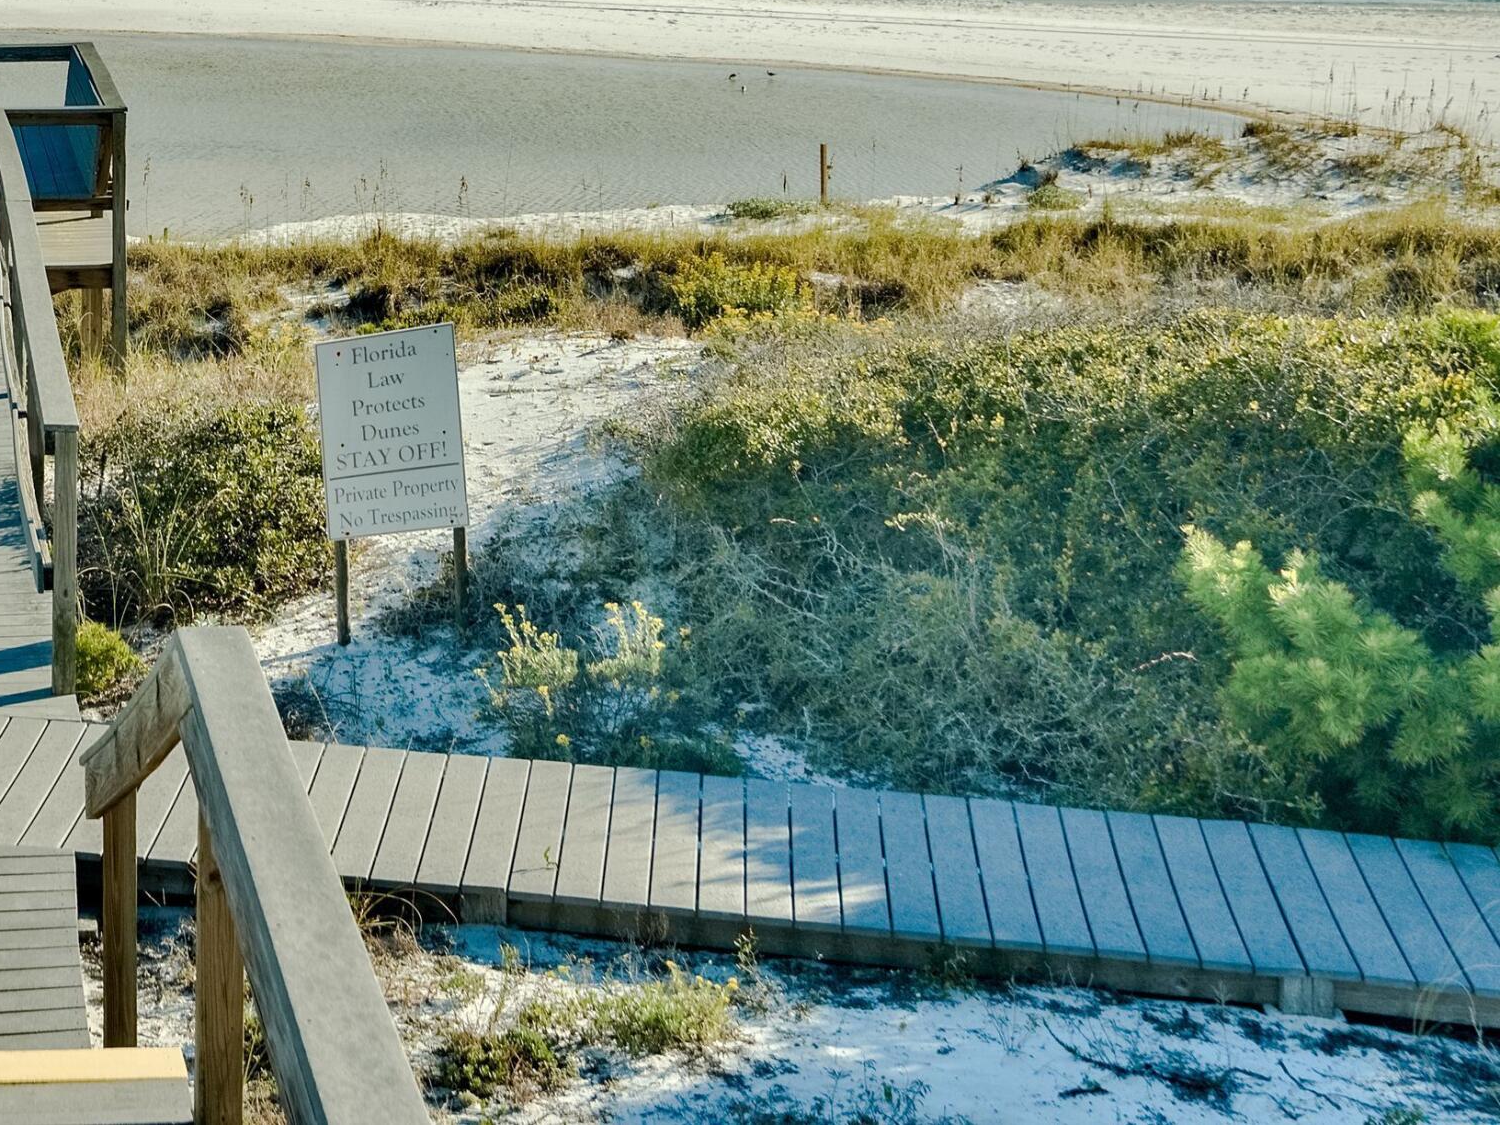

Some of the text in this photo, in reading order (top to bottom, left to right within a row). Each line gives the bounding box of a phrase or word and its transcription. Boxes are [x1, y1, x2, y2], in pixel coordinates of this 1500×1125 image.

[351, 341, 417, 364] Florida
[368, 372, 405, 389] Law
[352, 395, 425, 416] Protects
[362, 423, 419, 442] Dunes
[337, 441, 447, 471] STAY OFF!
[334, 478, 459, 504] Private Property
[340, 513, 363, 529] No
